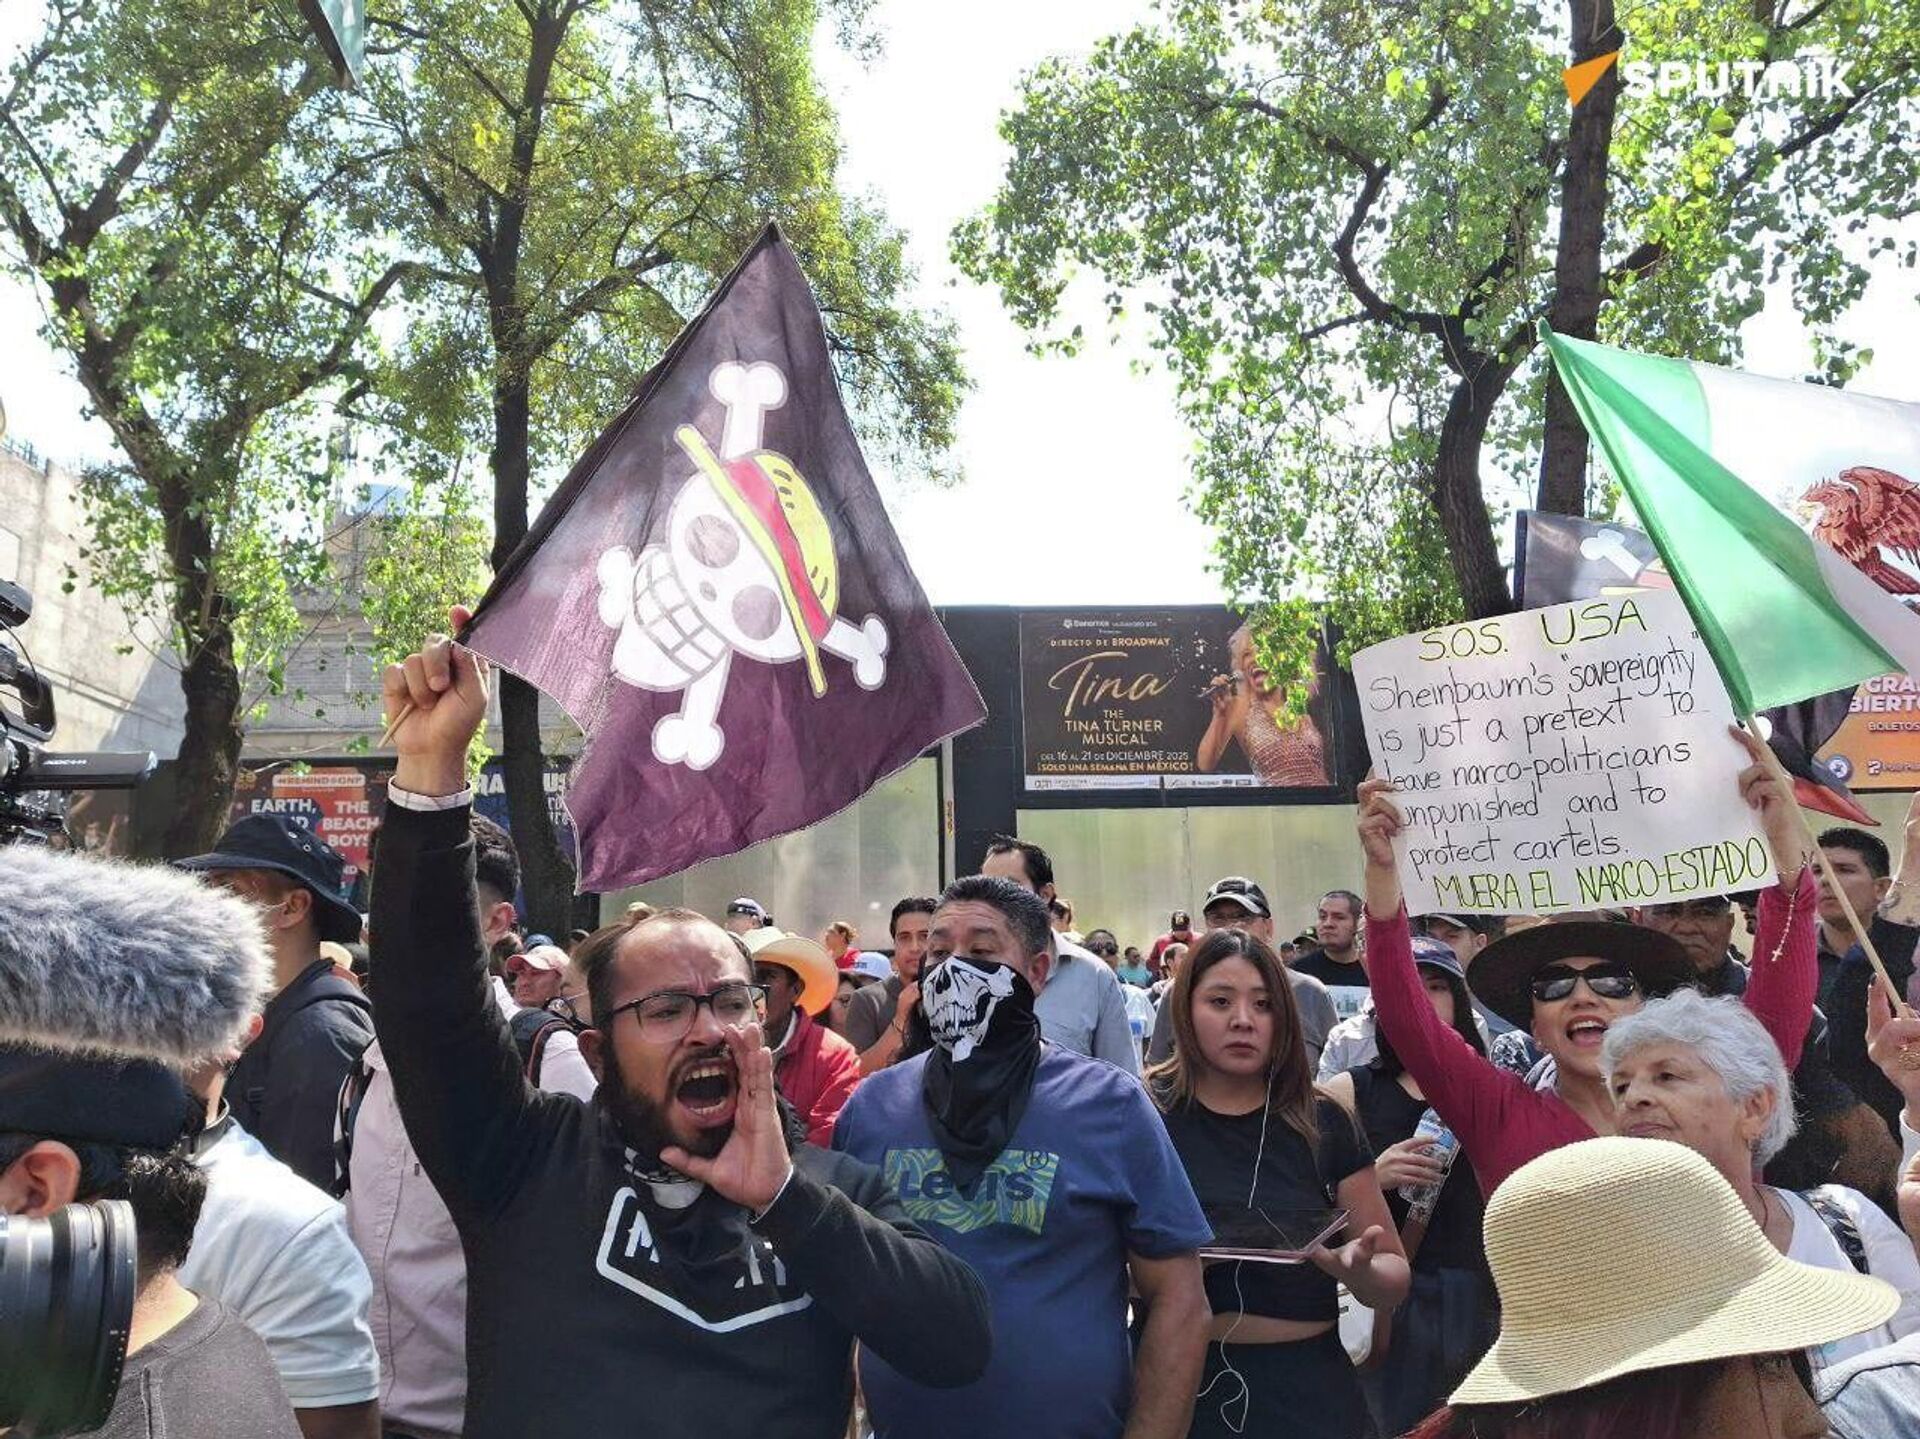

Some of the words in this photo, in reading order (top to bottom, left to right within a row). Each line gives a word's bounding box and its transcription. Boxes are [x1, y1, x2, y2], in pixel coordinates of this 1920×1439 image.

[1419, 623, 1508, 661] S.O.S.
[1541, 599, 1647, 645] USA
[1050, 638, 1092, 647] DIRECTO
[1096, 638, 1108, 647] DE
[1112, 637, 1171, 647] BROADWAY
[1048, 651, 1177, 717] Tina
[1370, 662, 1553, 711] Sheinbaum's
[1866, 675, 1920, 693] GRA
[1103, 709, 1125, 719] THE
[1064, 720, 1100, 732] TINA
[1104, 720, 1163, 732] TURNER
[1377, 728, 1402, 751] is
[1413, 704, 1470, 764] just
[1486, 719, 1509, 742] a
[1524, 687, 1632, 753] pretext
[1663, 682, 1694, 715] to
[1082, 734, 1148, 745] MUSICAL
[1057, 751, 1067, 761] 16
[1082, 751, 1091, 761] 21
[1106, 751, 1164, 761] DICIEMBRE
[1166, 752, 1189, 760] 2025
[1385, 759, 1441, 791] leave
[1453, 736, 1691, 793] narco-politicians
[1068, 763, 1089, 771] UNA
[1090, 763, 1128, 771] SEMANA
[1130, 762, 1144, 771] EN
[1569, 773, 1618, 813] and
[1630, 771, 1666, 804] to
[251, 798, 316, 814] EARTH,
[335, 801, 369, 813] THE
[322, 818, 379, 830] BEACH
[1409, 826, 1501, 881] protect
[1514, 818, 1628, 861] cartels.
[1433, 873, 1522, 909] MUERA
[1529, 871, 1569, 908] EL
[1576, 837, 1767, 904] NARCO-ESTADO
